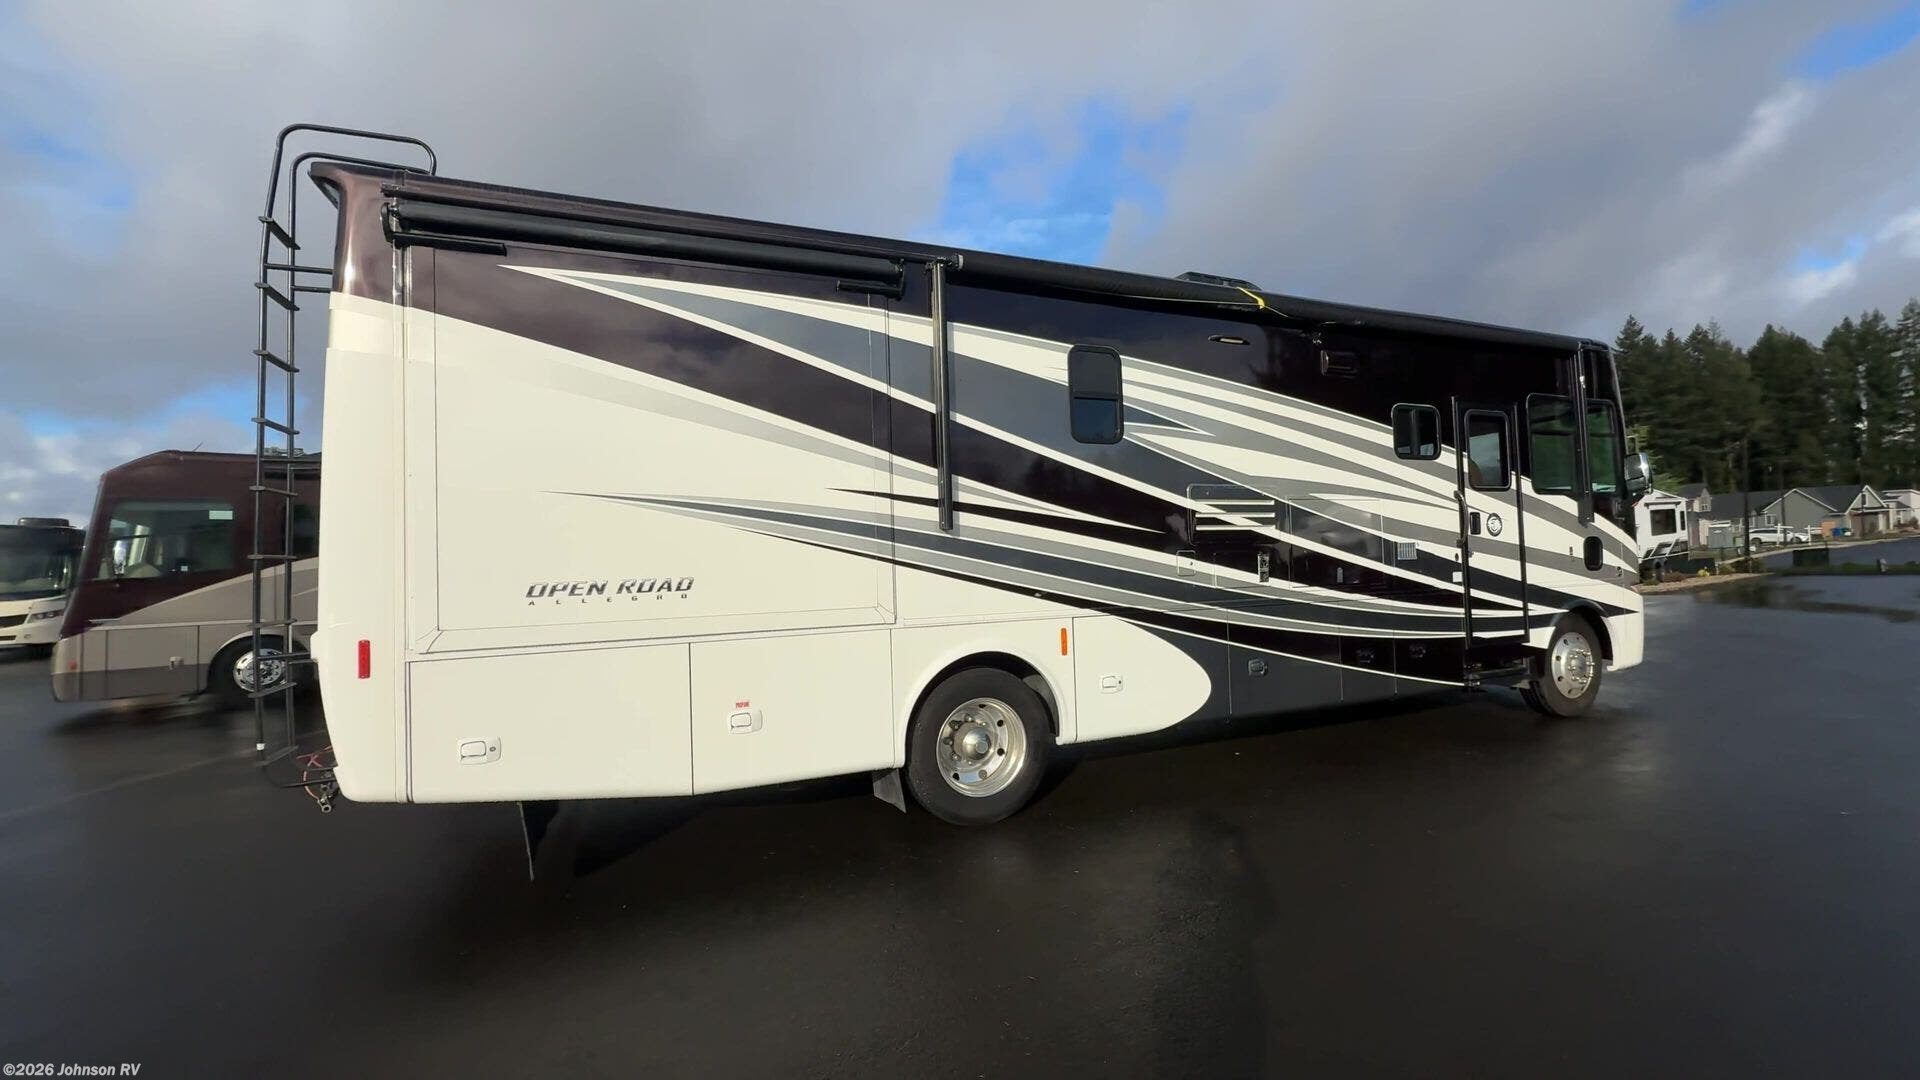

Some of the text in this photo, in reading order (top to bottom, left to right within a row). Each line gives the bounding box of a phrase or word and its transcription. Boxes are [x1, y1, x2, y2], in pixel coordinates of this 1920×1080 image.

[525, 577, 695, 598] OPEN ROAD
[528, 593, 688, 606] ALLEGRO
